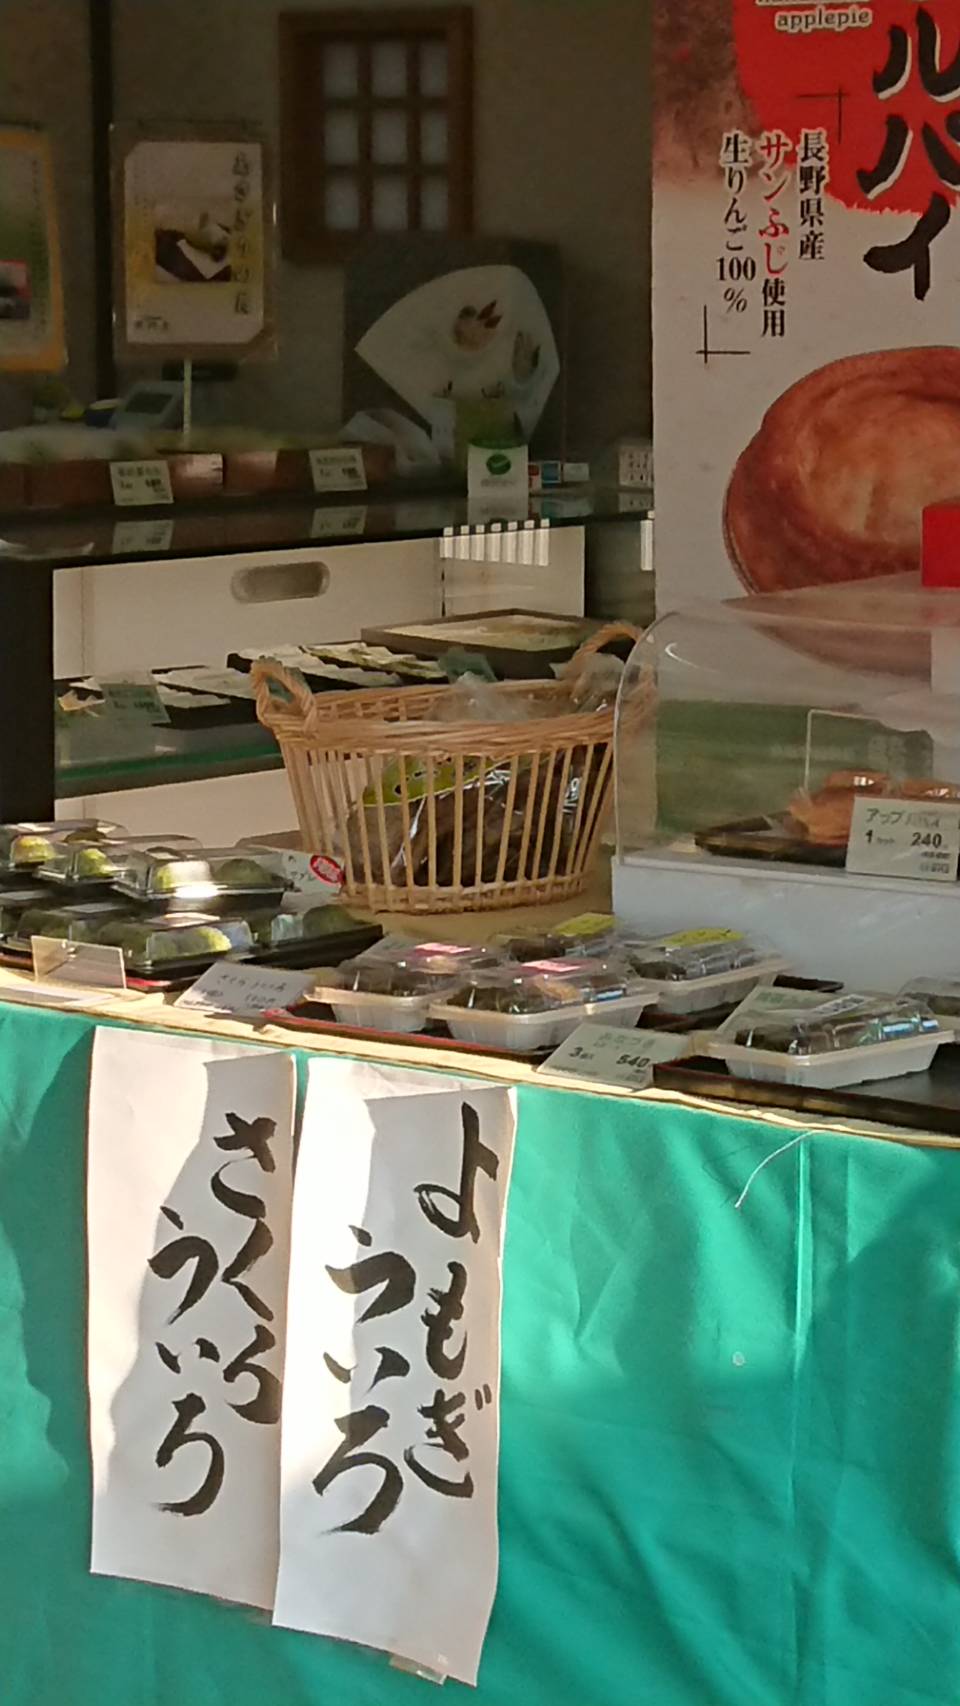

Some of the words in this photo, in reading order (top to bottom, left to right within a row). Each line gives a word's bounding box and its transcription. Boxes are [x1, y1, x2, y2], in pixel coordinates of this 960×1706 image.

[777, 9, 871, 30] applepie
[716, 133, 756, 313] 生りんご100%
[758, 133, 789, 338] サンふじ使用
[799, 131, 826, 260] 長野県産
[911, 832, 942, 849] 240
[616, 1054, 651, 1068] 540
[147, 1205, 226, 1517] ういろ
[210, 1112, 282, 1424] さくら
[403, 1102, 500, 1499] よもぎ
[311, 1224, 417, 1536] ういろ
